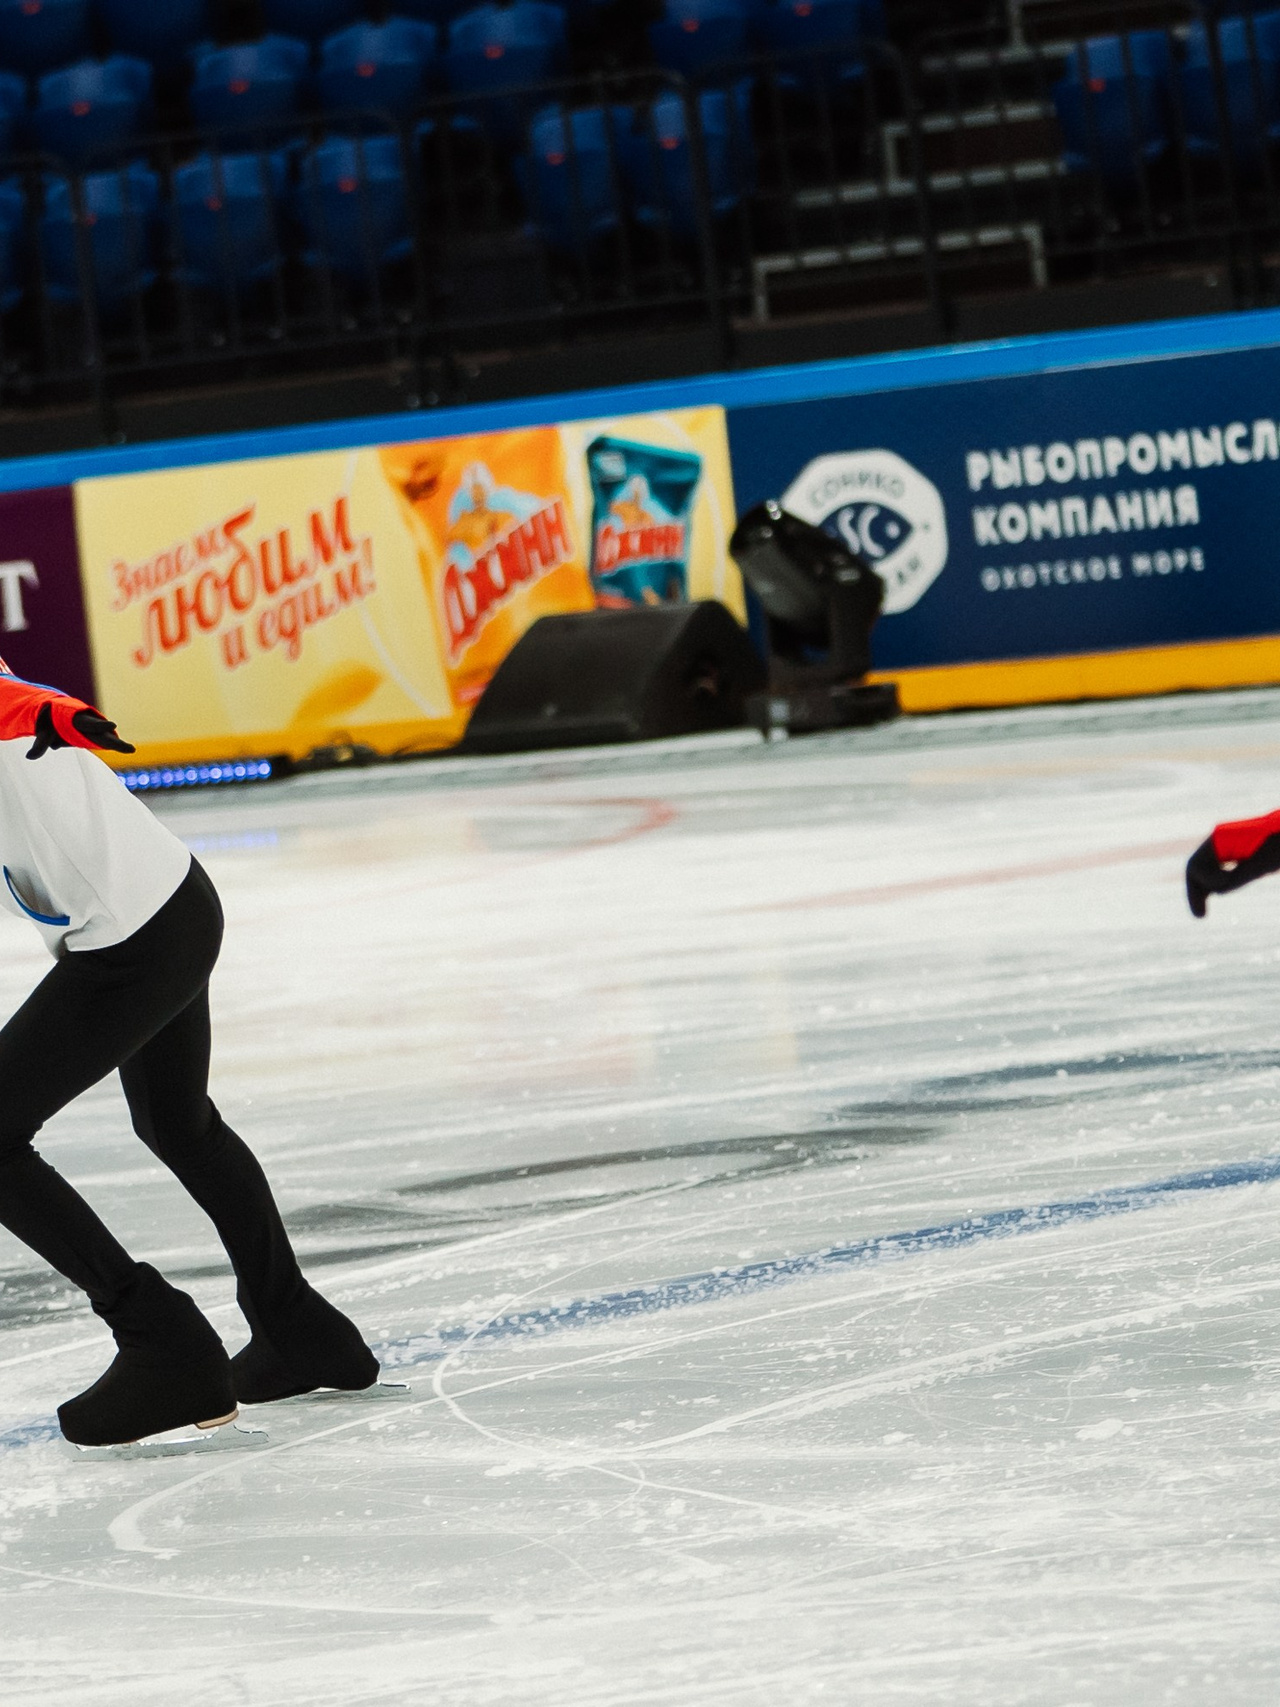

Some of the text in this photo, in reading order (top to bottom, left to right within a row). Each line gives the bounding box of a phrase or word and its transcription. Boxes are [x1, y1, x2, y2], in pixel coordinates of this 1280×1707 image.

[966, 417, 1280, 491] РЫБОПРОМЫСЛ
[973, 484, 1200, 546] КОМПАНИЯ
[980, 545, 1205, 592] ОХОТСКОЕ МОРЕ
